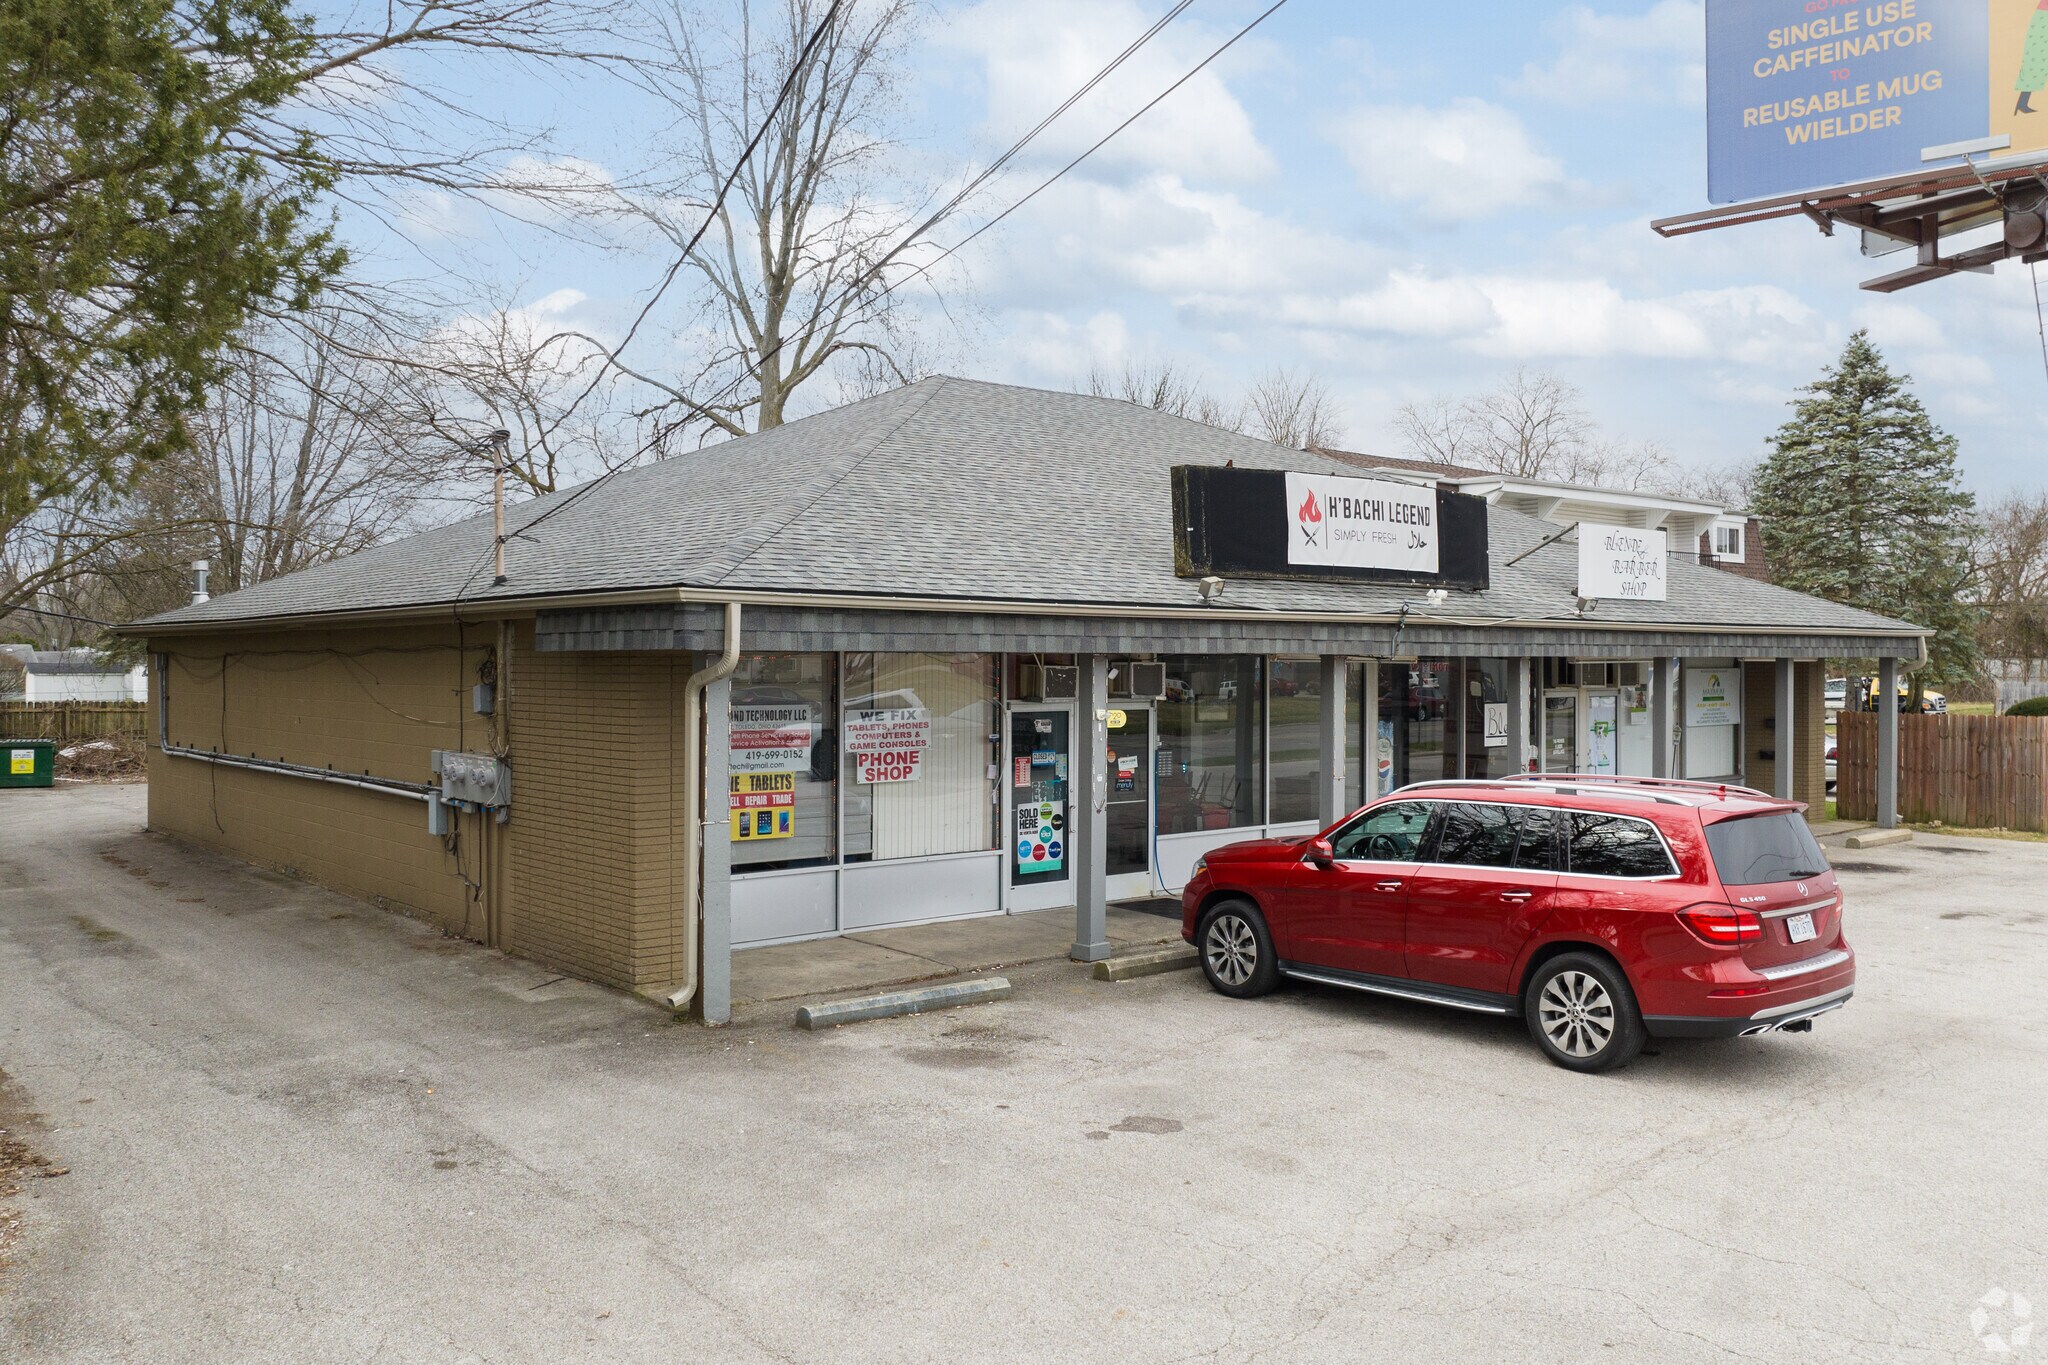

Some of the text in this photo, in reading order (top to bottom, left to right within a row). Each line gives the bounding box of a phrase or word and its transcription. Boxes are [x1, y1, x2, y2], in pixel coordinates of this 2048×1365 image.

[1805, 0, 1828, 13] GO
[1768, 0, 1916, 49] SINGLE USE
[1753, 22, 1933, 78] CAFFEINATOR
[1830, 68, 1850, 81] TO
[1743, 70, 1942, 128] REUSABLE MUG
[1785, 106, 1902, 145] WIELDER
[1329, 496, 1430, 526] H'BACHI LEGEND
[1334, 529, 1397, 544] SIMPLY FRESH
[1407, 530, 1427, 549] حلال
[1612, 556, 1660, 580] BARBER
[1620, 580, 1647, 597] SHOP
[746, 710, 792, 721] TECHNOLOGY
[794, 710, 807, 720] LLC
[860, 710, 916, 721] WE FIX
[893, 722, 929, 730] PHONES
[855, 732, 912, 740] COMPUTERS
[850, 740, 926, 750] GAME CONSOLES
[745, 750, 803, 760] 419-699-0152
[858, 751, 919, 767] PHONE
[730, 762, 784, 770] tech@gmail.com
[865, 766, 913, 782] SHOP
[749, 774, 792, 791] TABLETS
[730, 794, 792, 806] ELL REPAIR TRADE
[1019, 808, 1038, 819] SOLD
[1019, 818, 1038, 829] HERE
